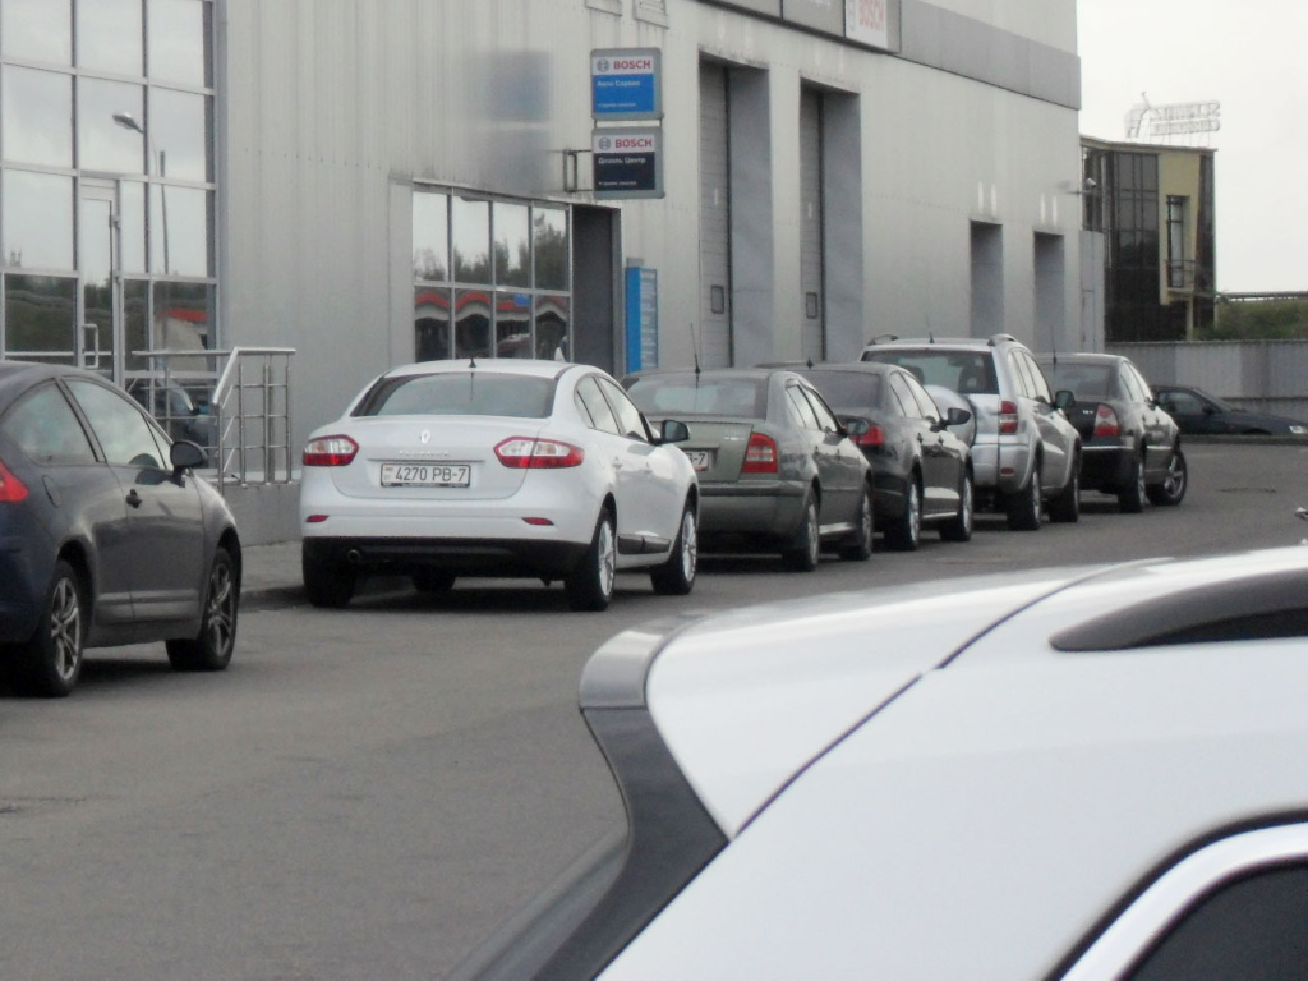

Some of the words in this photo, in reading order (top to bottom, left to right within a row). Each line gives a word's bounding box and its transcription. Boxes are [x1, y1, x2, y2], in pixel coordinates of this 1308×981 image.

[613, 60, 651, 70] BOSCH
[615, 139, 652, 149] BOSCH
[395, 466, 428, 481] 4270
